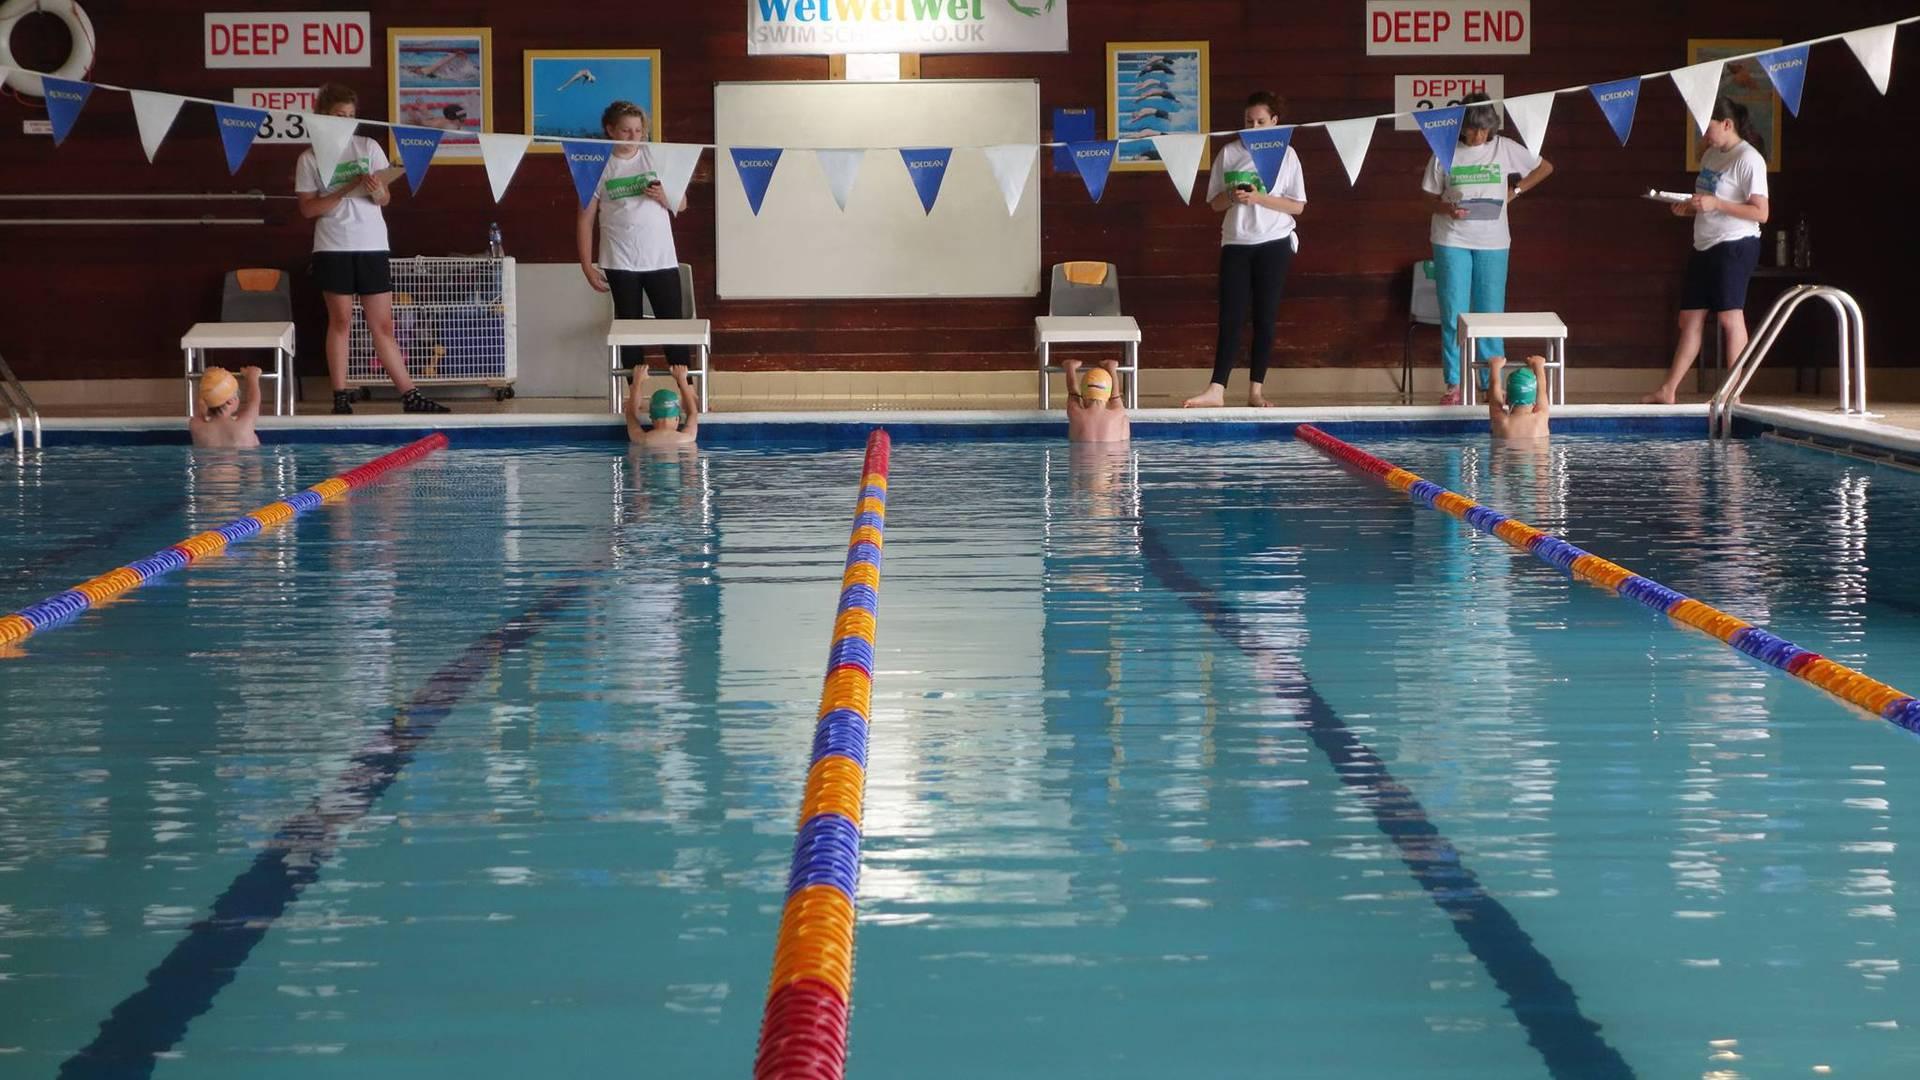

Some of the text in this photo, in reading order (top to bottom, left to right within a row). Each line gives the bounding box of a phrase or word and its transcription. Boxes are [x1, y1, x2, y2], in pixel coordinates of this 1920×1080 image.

[210, 23, 364, 55] DEEP END
[757, 26, 816, 43] SWIM
[1372, 10, 1525, 43] DEEP END
[1413, 80, 1486, 98] DEPTH
